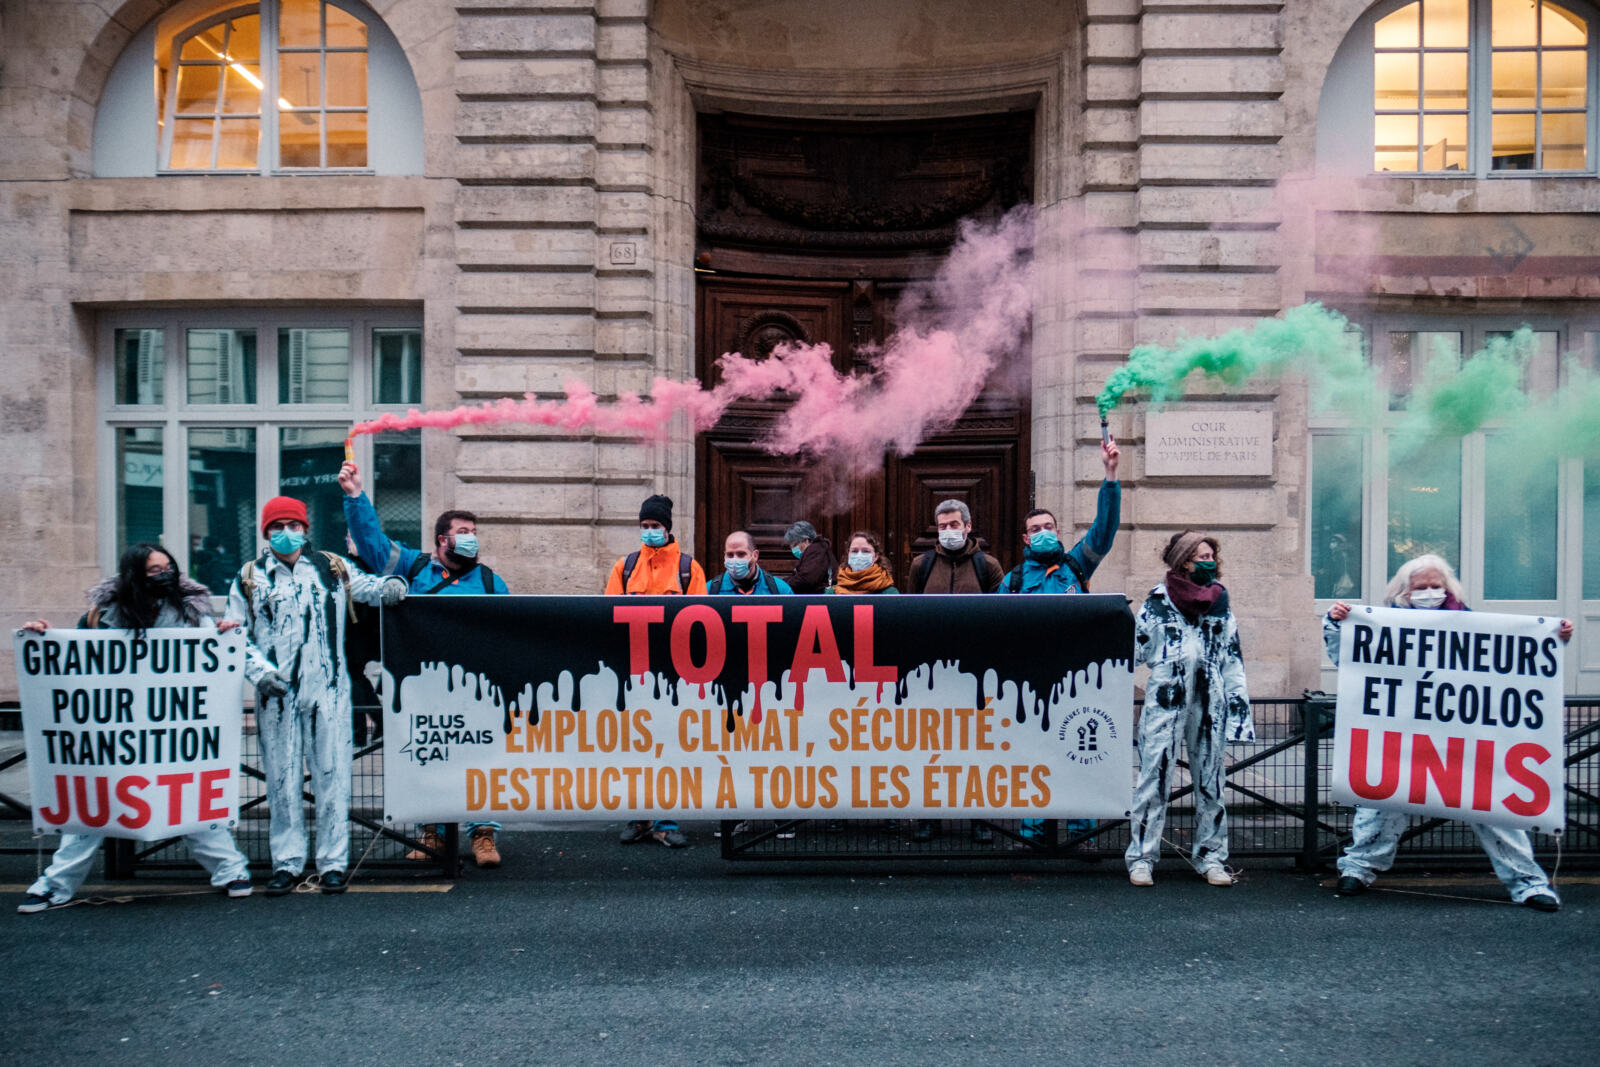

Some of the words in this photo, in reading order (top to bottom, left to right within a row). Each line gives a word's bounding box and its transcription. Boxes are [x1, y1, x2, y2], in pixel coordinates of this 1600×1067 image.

[614, 246, 632, 258] 68
[1158, 436, 1261, 447] ADMINISTRATIVE
[1191, 422, 1226, 432] COUR
[1158, 451, 1205, 462] D'APPEL
[1207, 451, 1222, 461] DE
[1224, 451, 1257, 462] PARIS
[613, 604, 898, 684] TOTAL
[1352, 624, 1558, 678] RAFFINEURS
[52, 688, 134, 724] POUR
[147, 685, 208, 722] UNE
[1083, 706, 1090, 714] DE
[1363, 676, 1403, 717] ET
[1414, 671, 1544, 730] ÉCOLOS
[415, 714, 465, 729] PLUS
[505, 708, 664, 758] EMPLOIS,
[678, 708, 815, 758] CLIMAT,
[42, 726, 221, 766] TRANSITION
[415, 730, 494, 745] JAMAIS
[415, 747, 449, 766] ÇA!
[1066, 751, 1077, 761] EN
[466, 766, 702, 811] DESTRUCTION
[715, 755, 737, 809] À
[749, 765, 839, 809] TOUS
[851, 764, 911, 809] LES
[923, 754, 1051, 808] ÉTAGES
[1348, 727, 1552, 817] UNIS
[39, 768, 231, 829] JUSTE
